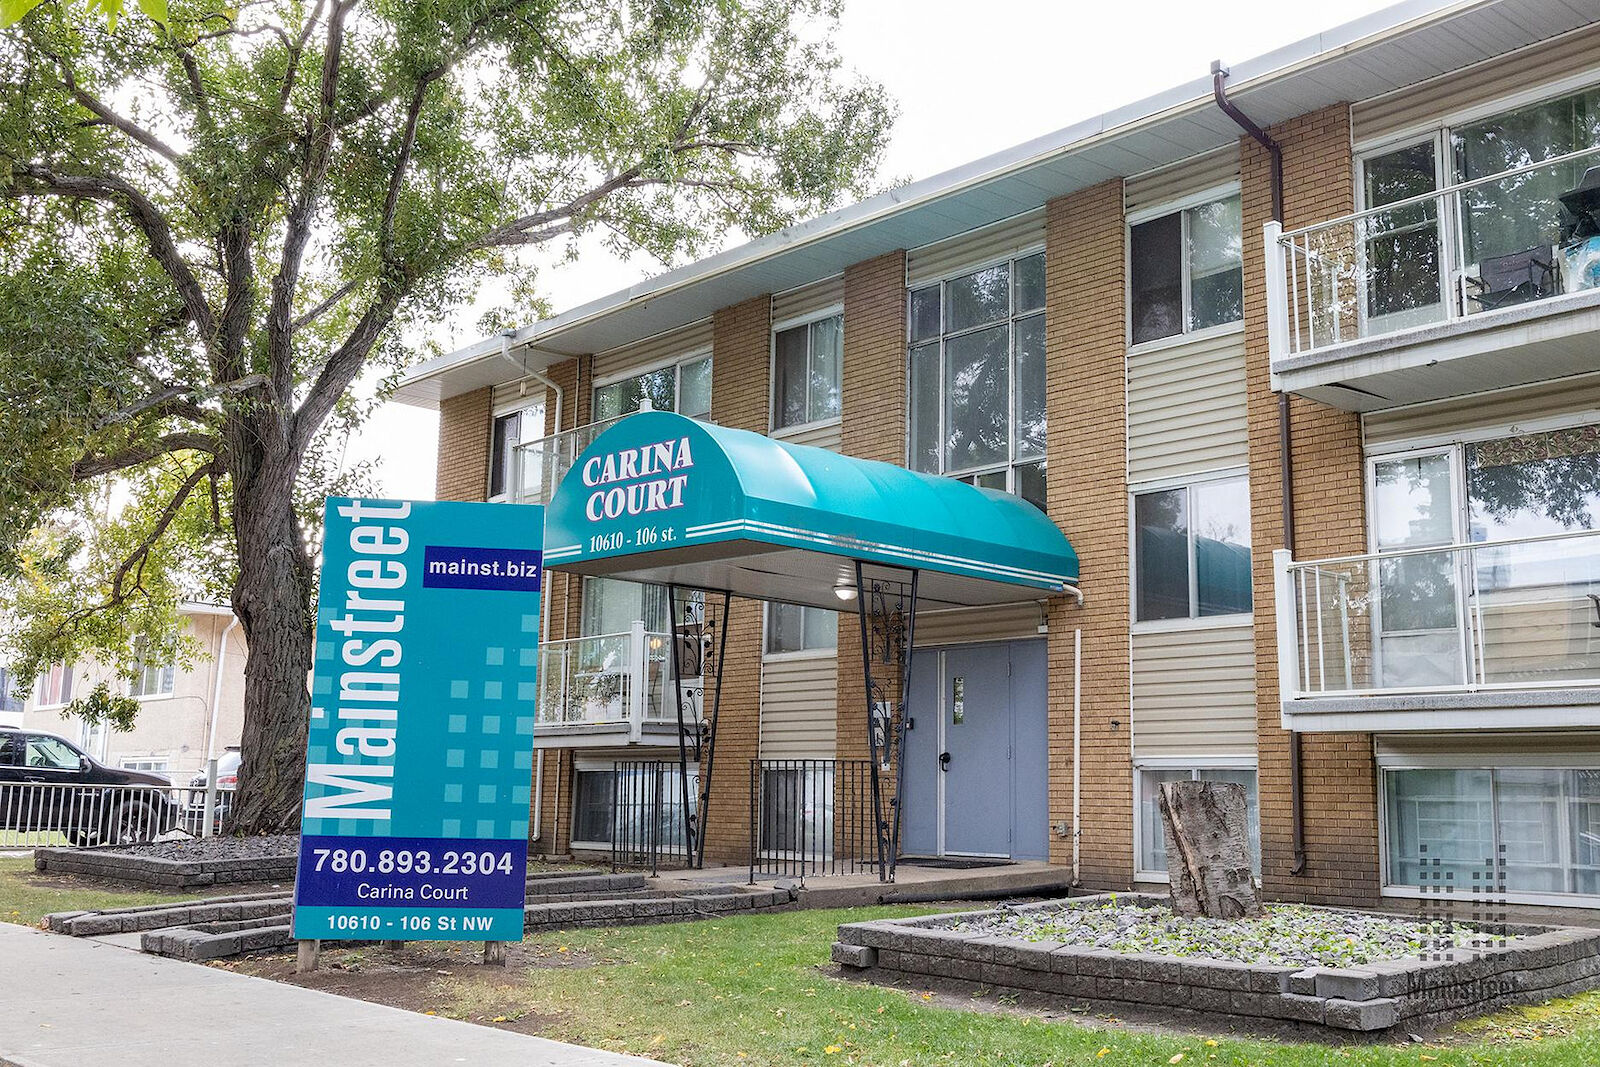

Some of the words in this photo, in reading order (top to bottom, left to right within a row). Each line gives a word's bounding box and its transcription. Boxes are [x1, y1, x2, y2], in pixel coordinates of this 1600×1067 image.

[583, 437, 694, 487] CARINA
[586, 475, 688, 522] COURT
[589, 531, 623, 553] 10610
[636, 526, 657, 547] 106
[661, 526, 677, 542] st.
[429, 559, 537, 578] mainst.biz
[304, 501, 412, 820] Mainstreet
[313, 849, 513, 875] 780.893.2304
[357, 883, 414, 899] Carina
[420, 884, 469, 900] Court
[328, 915, 381, 930] 10610
[400, 915, 431, 931] 106
[437, 916, 456, 931] St
[463, 917, 493, 931] NW
